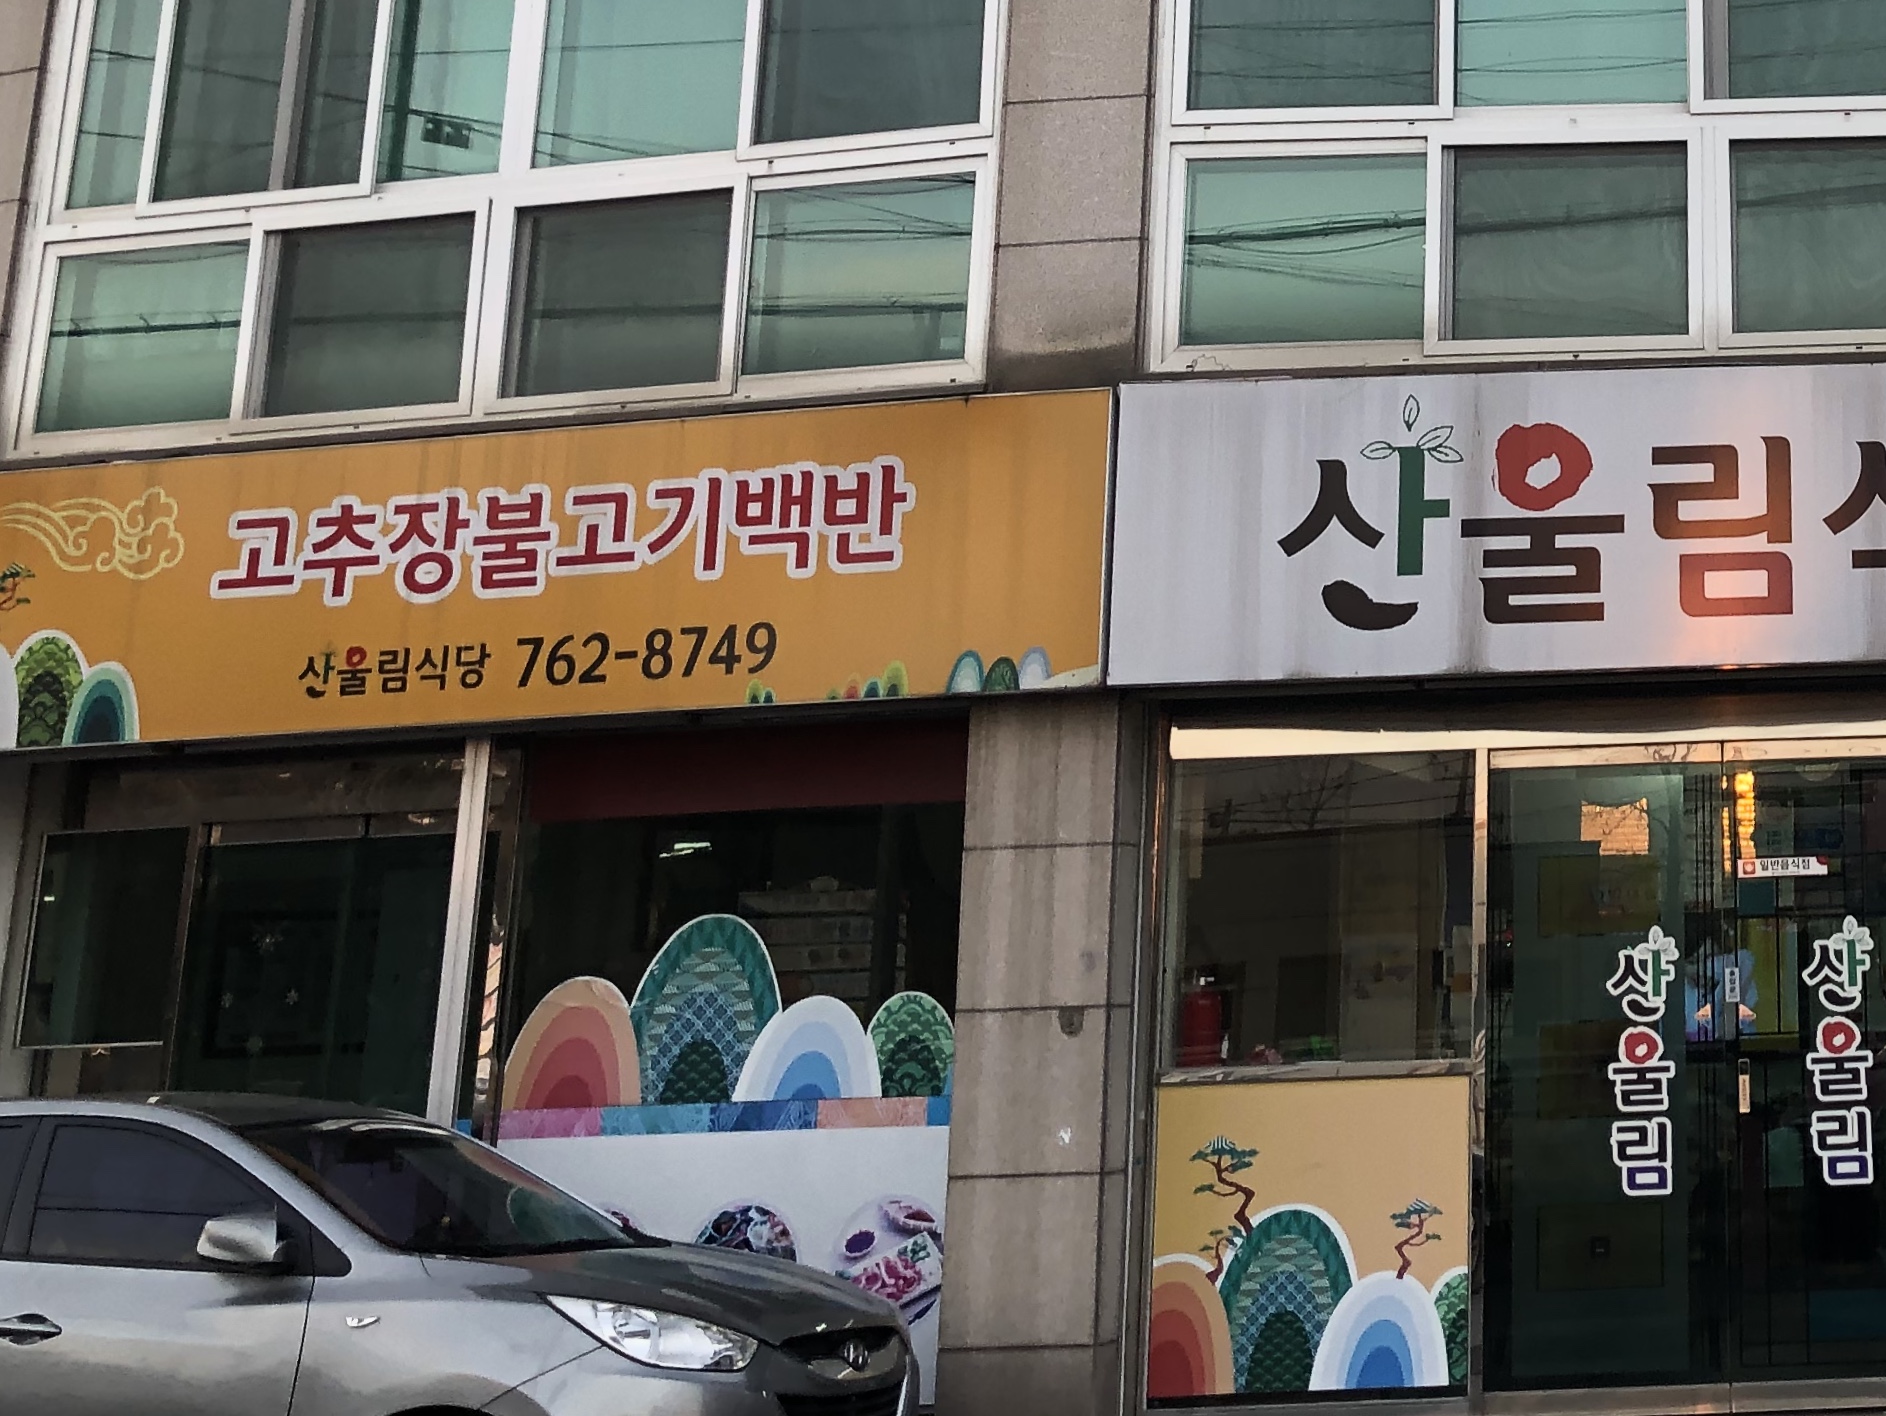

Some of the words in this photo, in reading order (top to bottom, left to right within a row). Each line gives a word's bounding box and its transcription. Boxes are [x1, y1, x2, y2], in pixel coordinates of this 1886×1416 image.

[213, 459, 913, 602] 고추장불고기백반
[298, 637, 492, 700] 산울림식당
[515, 620, 779, 689] 762-8749
[1608, 927, 1679, 1196] 산울림
[1803, 917, 1873, 1185] 산울림
